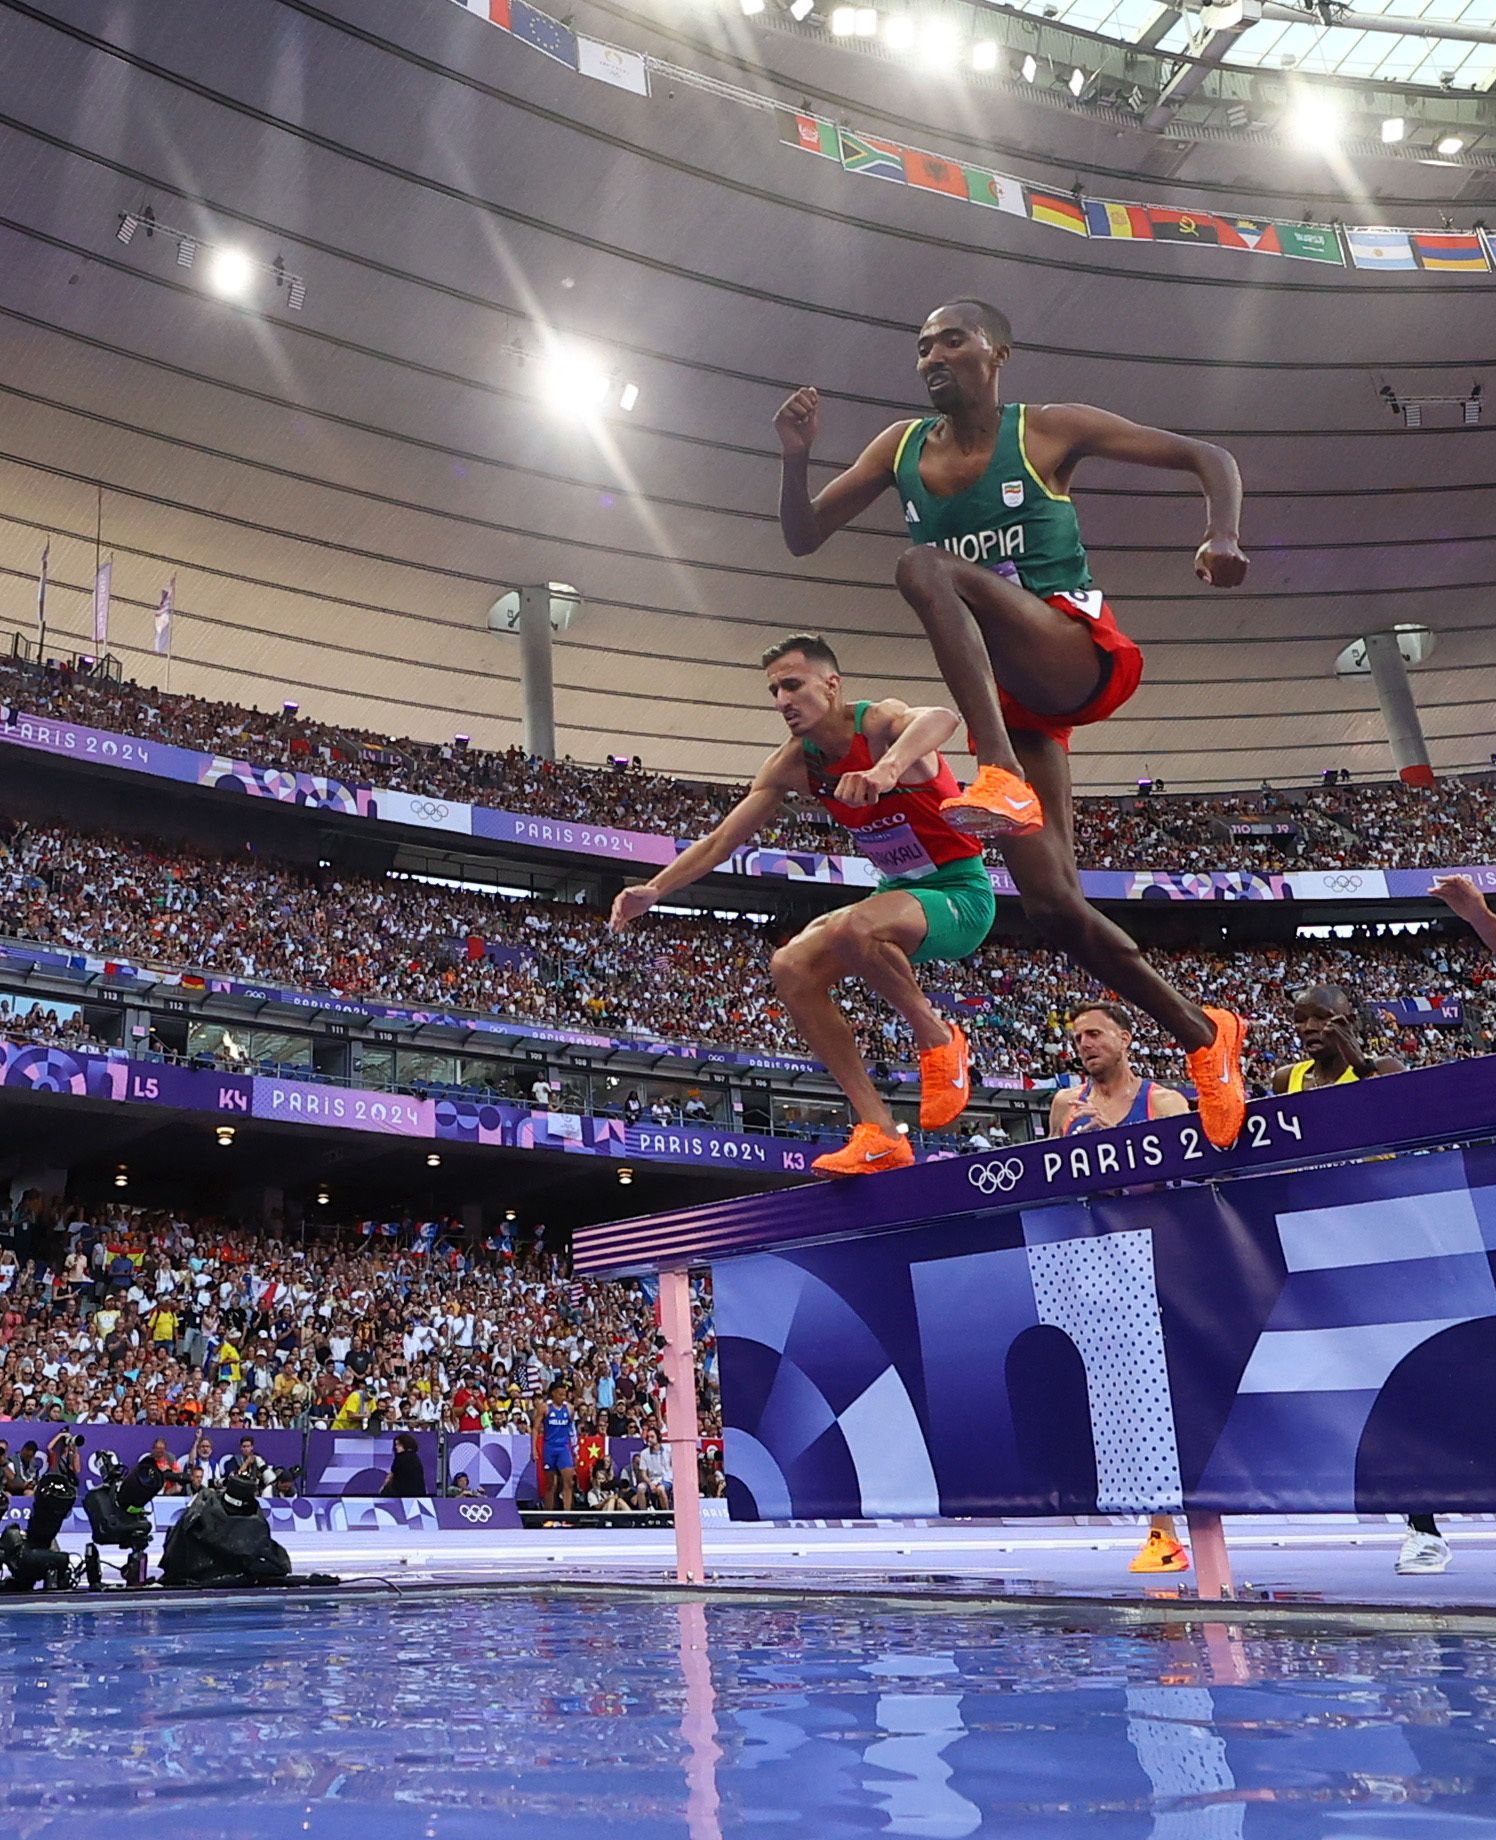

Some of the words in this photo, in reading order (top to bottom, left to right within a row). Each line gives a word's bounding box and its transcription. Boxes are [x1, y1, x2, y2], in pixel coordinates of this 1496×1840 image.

[87, 737, 149, 764] 2024
[514, 821, 574, 843] PARIS
[581, 831, 633, 852] 2024
[103, 990, 118, 1001] 113
[169, 1000, 184, 1011] 112
[1442, 1006, 1458, 1018] K7
[134, 1075, 159, 1099] L5
[219, 1087, 248, 1112] K4
[273, 1089, 345, 1117] PARIS
[355, 1101, 418, 1126] 2024
[640, 1133, 702, 1156] PARIS
[710, 1139, 766, 1163] 2024
[1044, 1136, 1163, 1183] PARIS
[1179, 1111, 1303, 1161] 224
[783, 1151, 805, 1170] K3
[2, 1508, 31, 1520] 202
